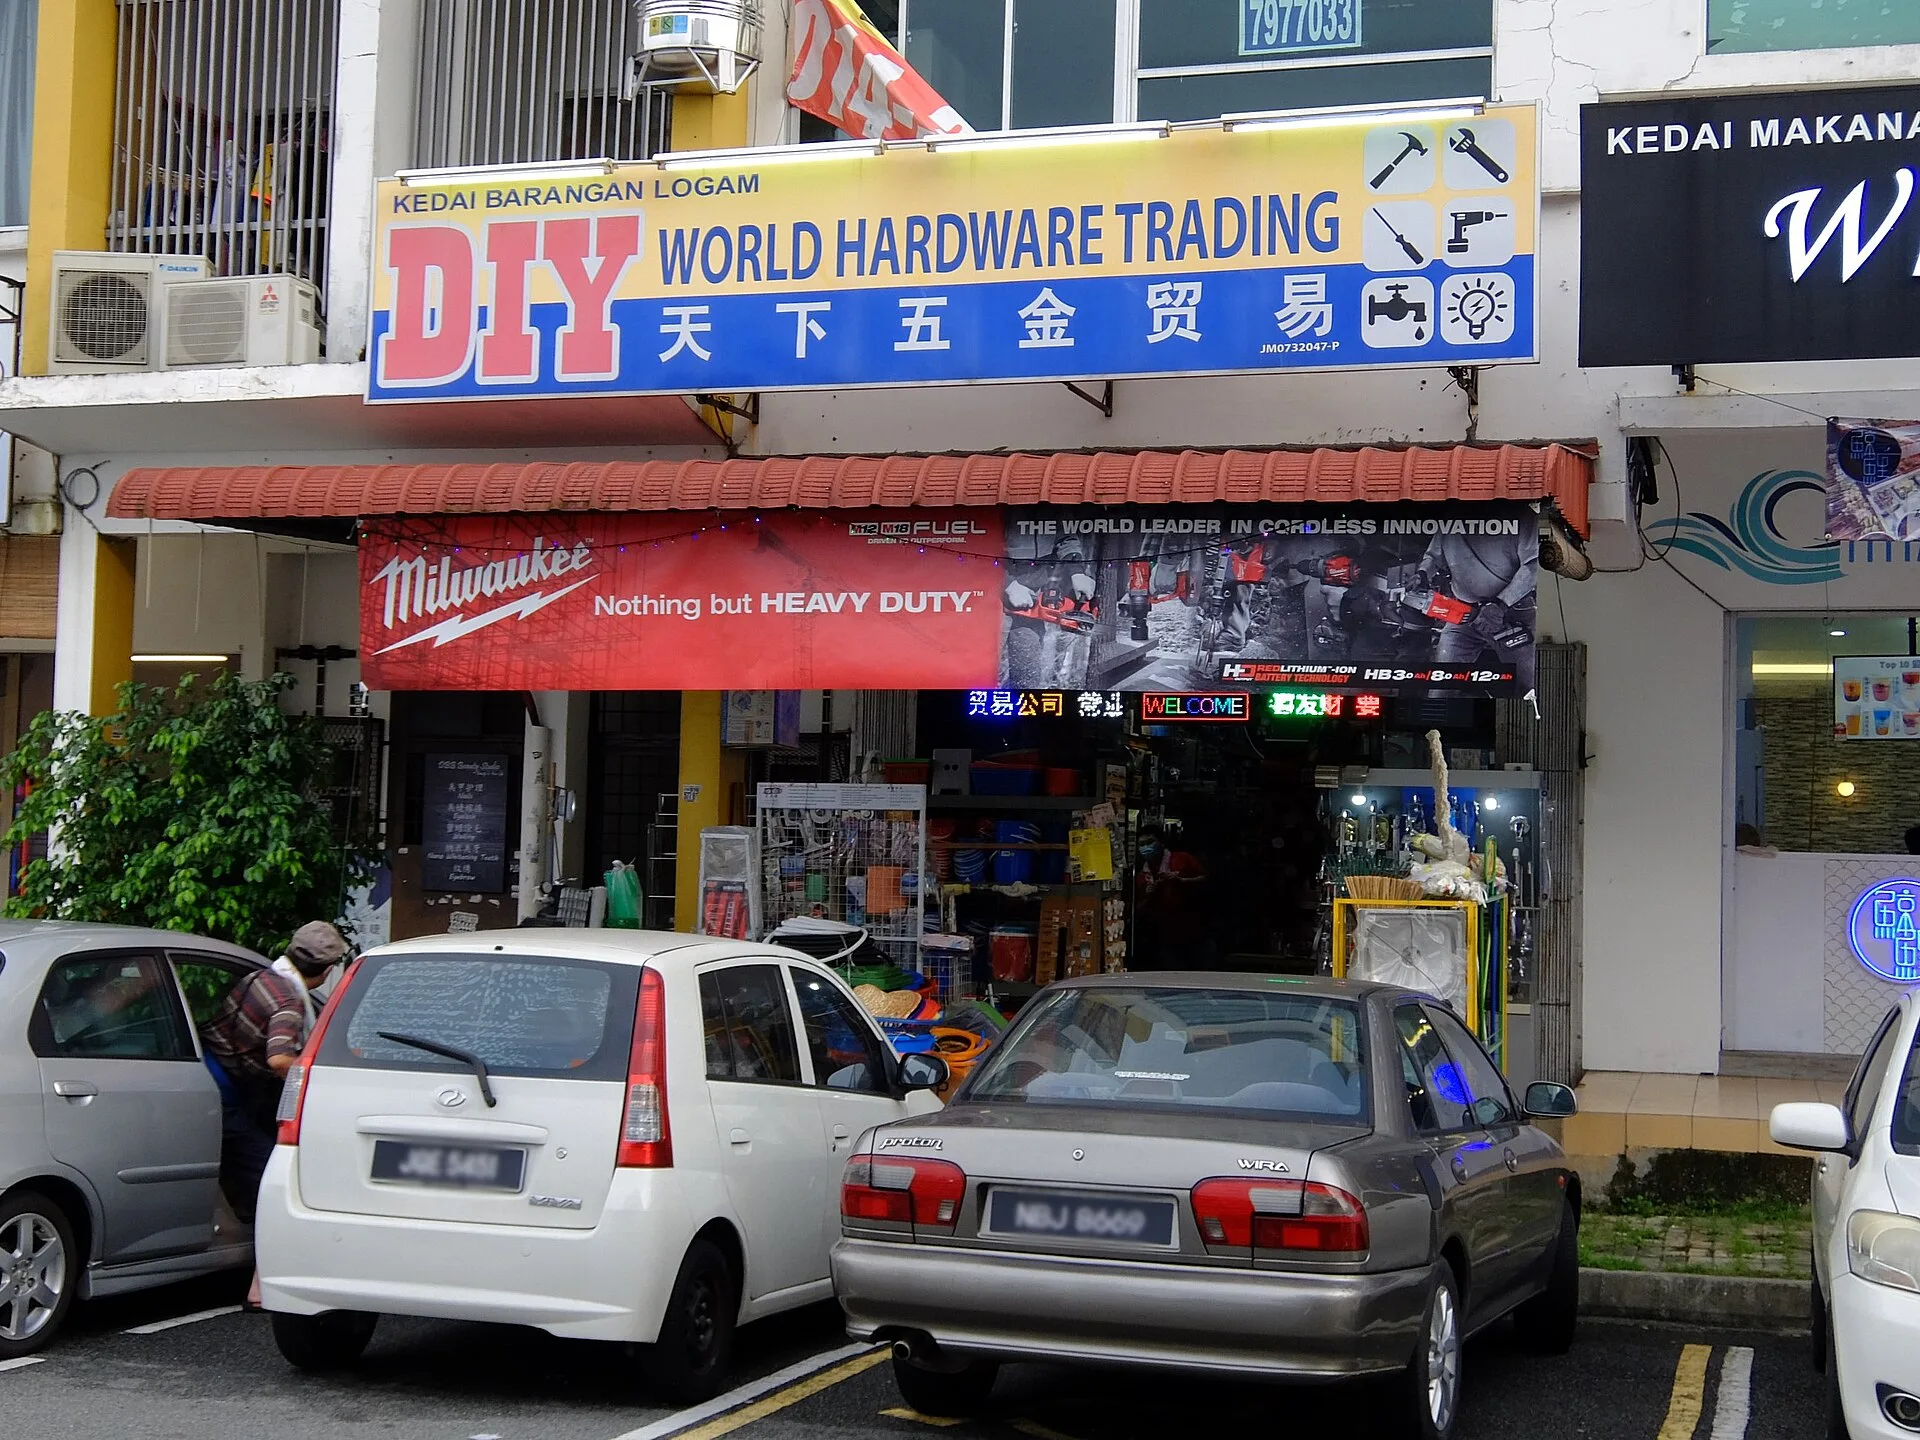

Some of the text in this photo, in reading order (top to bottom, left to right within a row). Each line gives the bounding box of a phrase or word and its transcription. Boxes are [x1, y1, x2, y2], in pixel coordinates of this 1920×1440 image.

[1250, 0, 1353, 46] 7977033
[1607, 121, 1732, 155] KEDAI
[393, 173, 760, 214] KEDAI BARANGAN LOGAM
[658, 190, 1340, 286] WORLD HARDWARE TRADING
[1764, 167, 1920, 283] W
[380, 211, 642, 385] DIY
[658, 274, 1334, 364] 天下五金贸易
[1260, 341, 1340, 354] JM0732047-P
[881, 522, 910, 534] M18
[914, 521, 987, 535] FUEL
[1017, 519, 1519, 535] THE WORLD LEADER IN CORDLESS INNOVATION
[594, 594, 701, 620] Nothing
[710, 593, 753, 614] but
[761, 592, 870, 613] HEAVY
[1255, 673, 1292, 682] BATTERY
[1294, 674, 1350, 683] TECHNOLOGY
[1145, 697, 1244, 714] WELCOME
[878, 1137, 944, 1150] proton
[1236, 1158, 1290, 1172] WIRA
